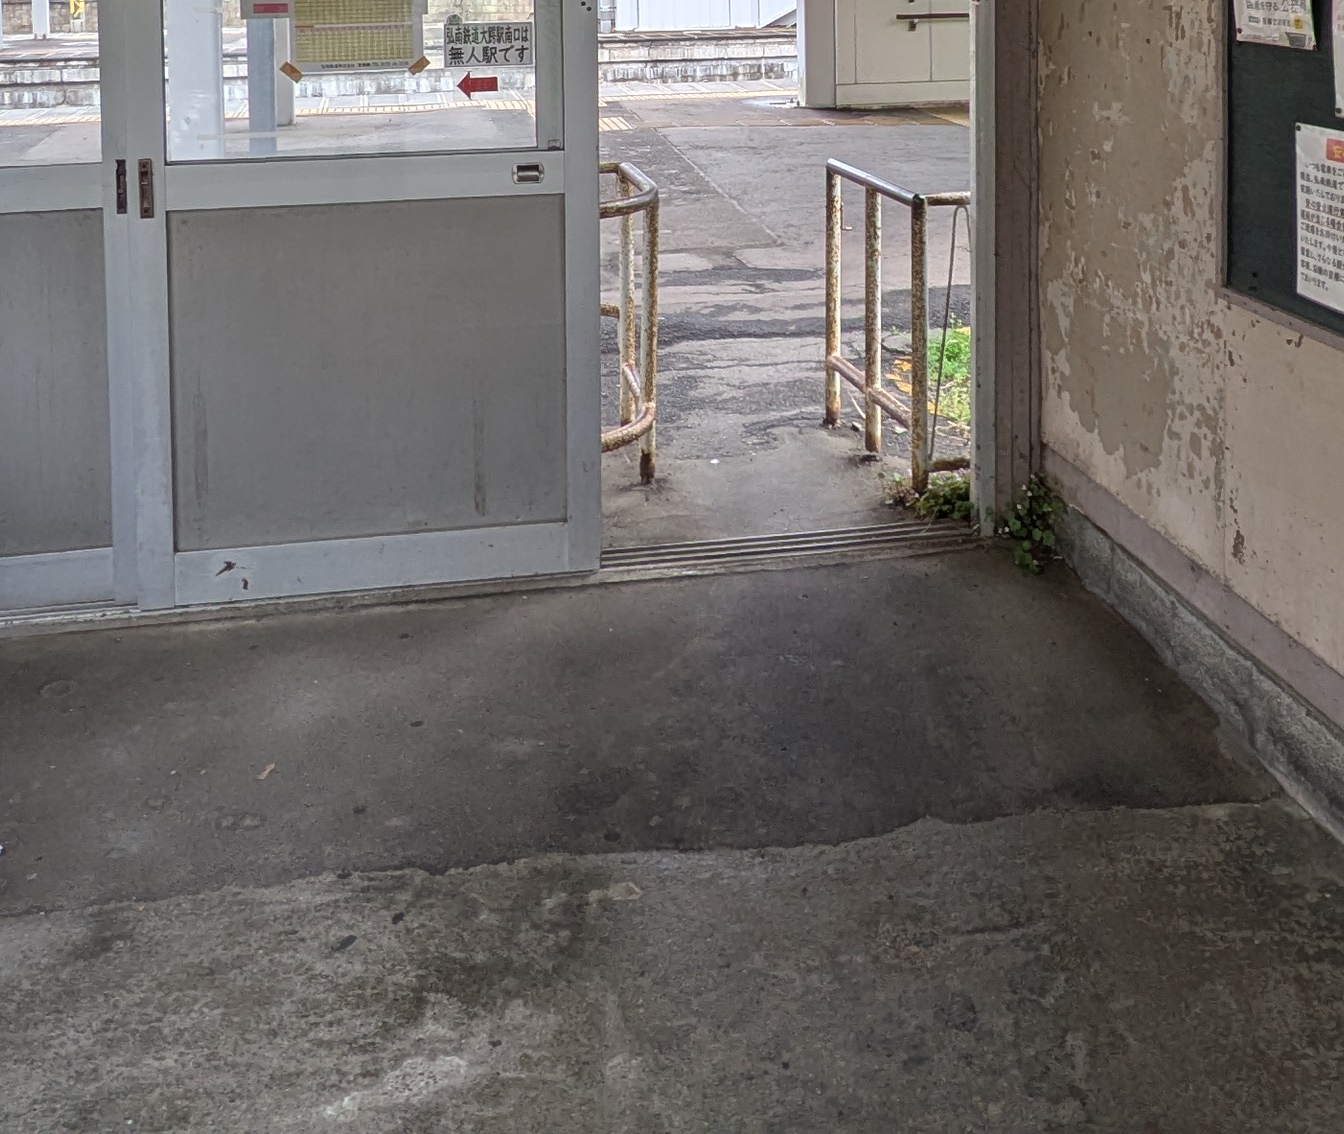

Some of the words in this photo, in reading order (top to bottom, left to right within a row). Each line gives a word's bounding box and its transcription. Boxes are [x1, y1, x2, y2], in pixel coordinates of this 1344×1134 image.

[447, 26, 529, 45] 弘南鉄道大鰐駅南口は
[449, 45, 529, 65] 無人駅です
